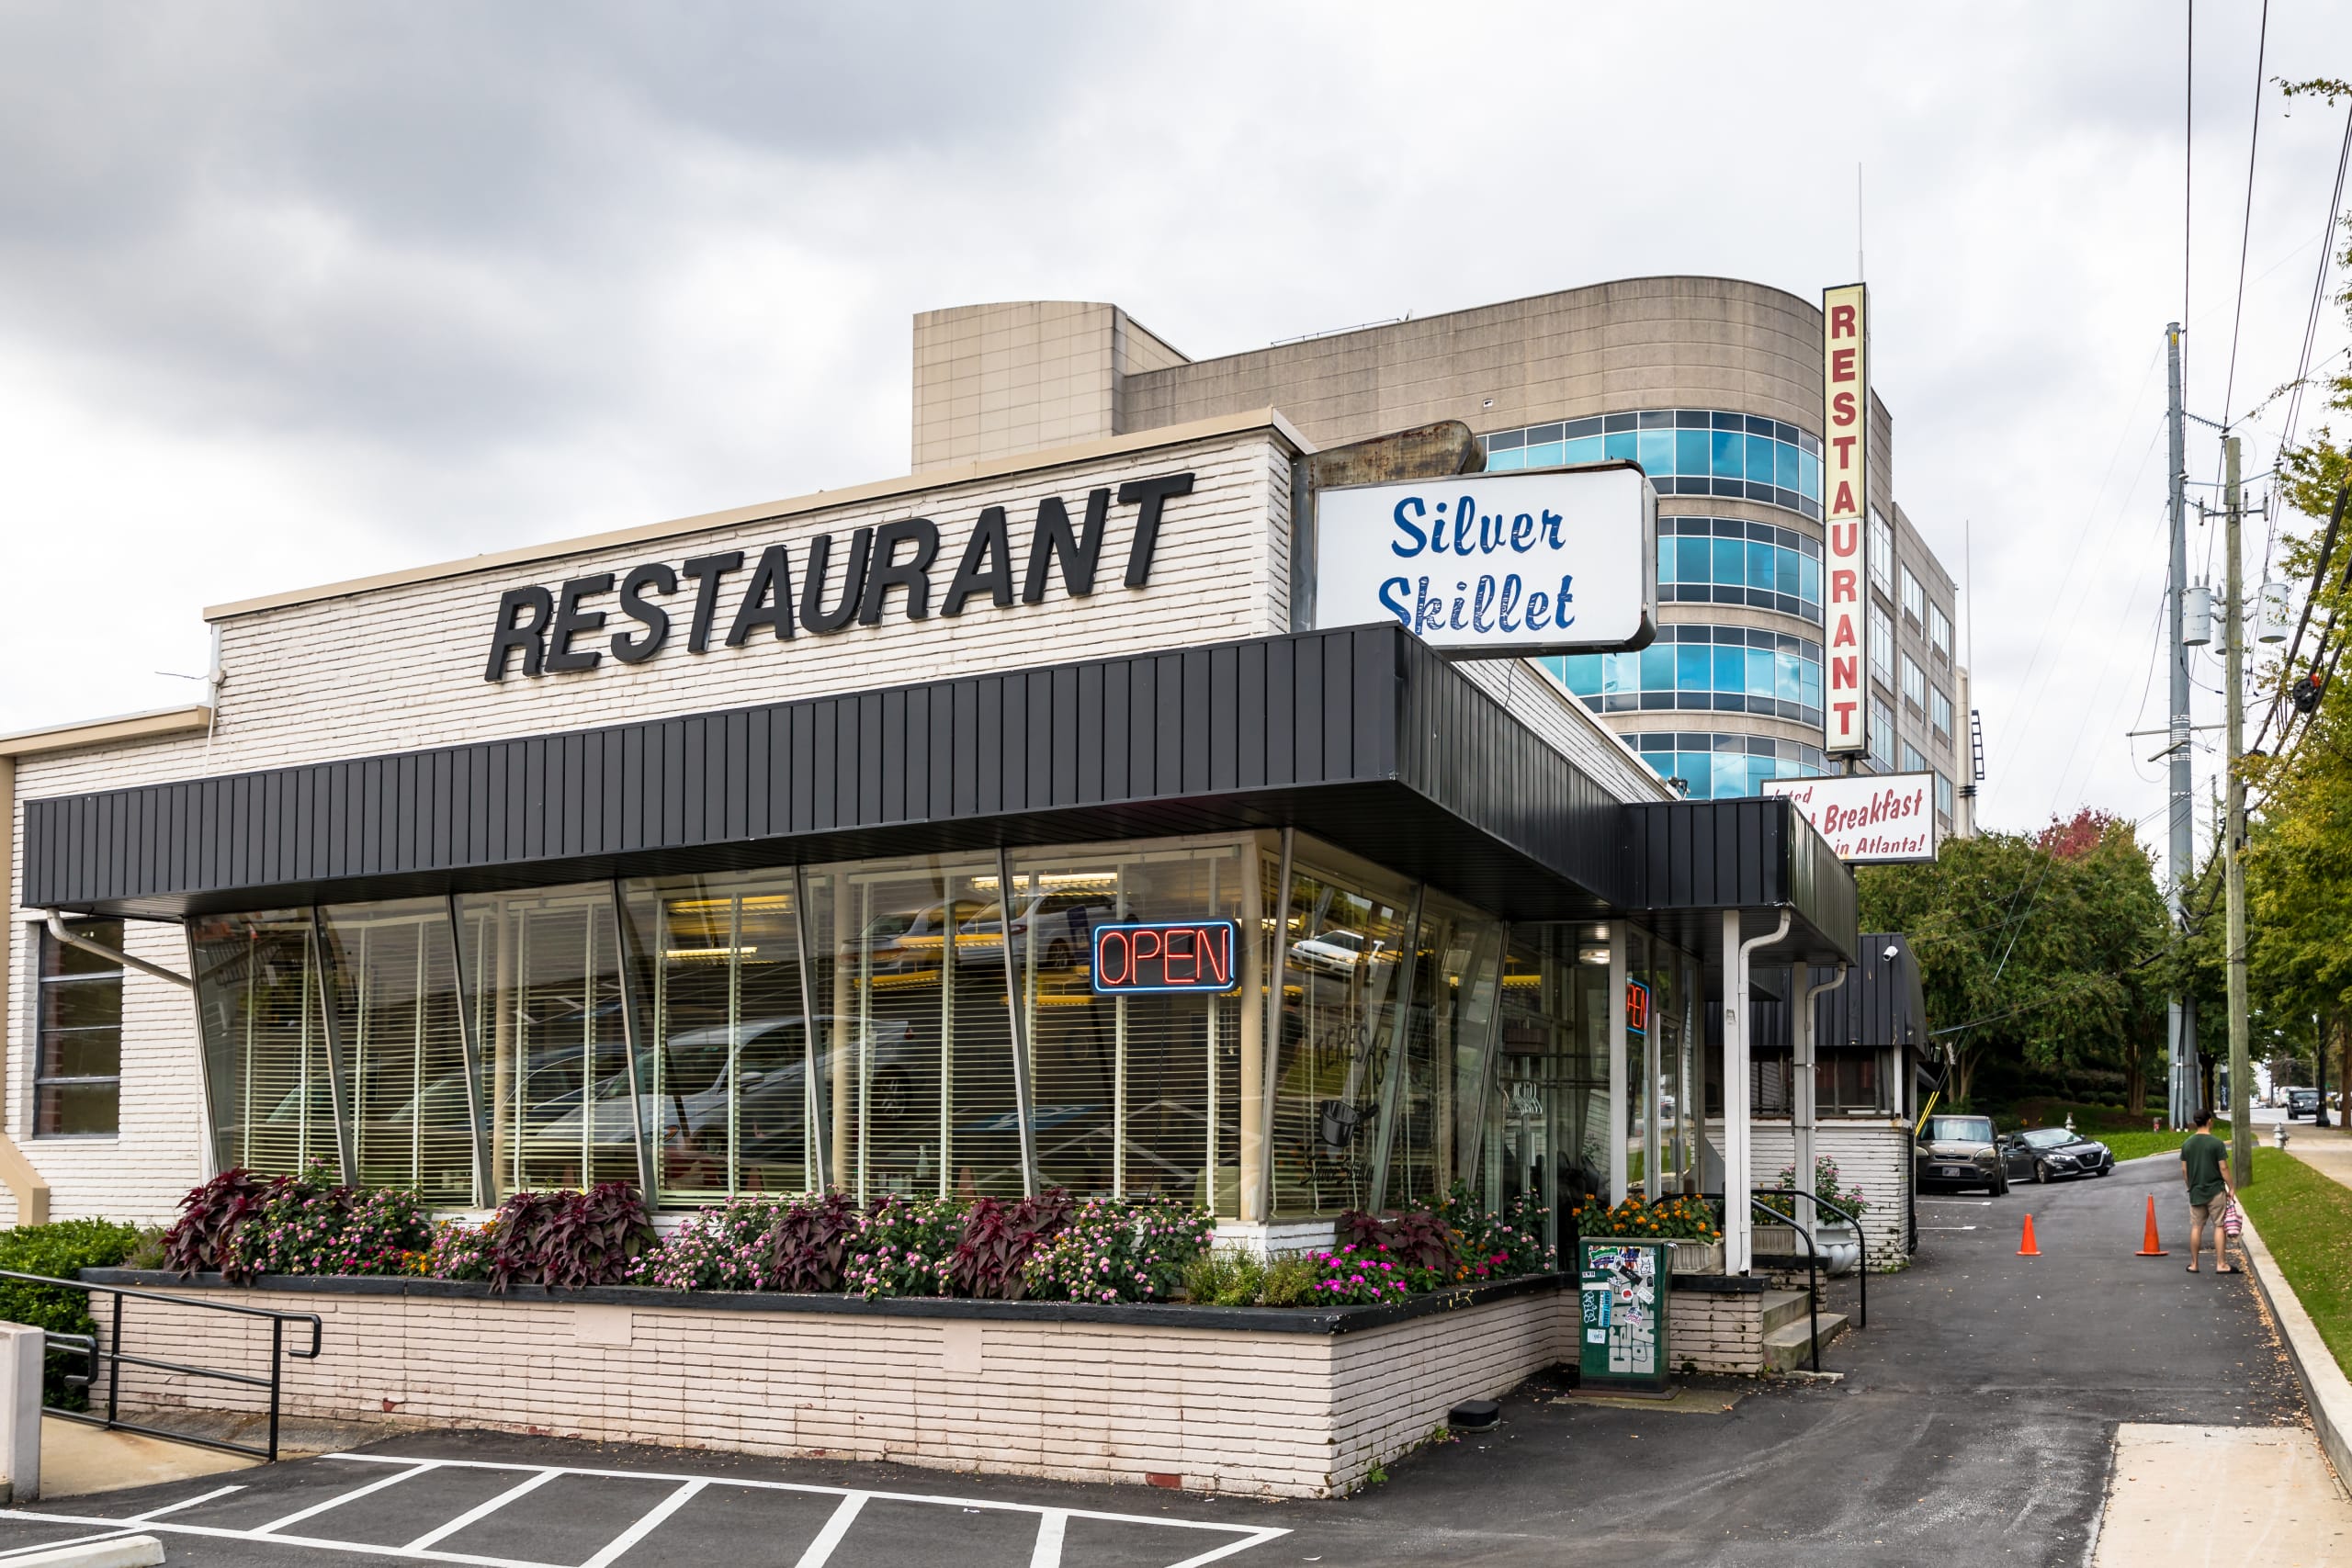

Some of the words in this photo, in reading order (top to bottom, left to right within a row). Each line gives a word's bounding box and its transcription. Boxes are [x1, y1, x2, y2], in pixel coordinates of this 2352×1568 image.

[1391, 495, 1566, 558] Silver
[1831, 304, 1858, 736] RESTAURANT
[484, 472, 1195, 682] RESTAURANT
[1378, 573, 1576, 636] Skillet
[1824, 788, 1923, 835] Breakfast
[1834, 839, 1849, 855] in
[1855, 833, 1926, 855] Atlanta!
[1099, 927, 1229, 986] OPEN
[1626, 983, 1648, 1030] PEN
